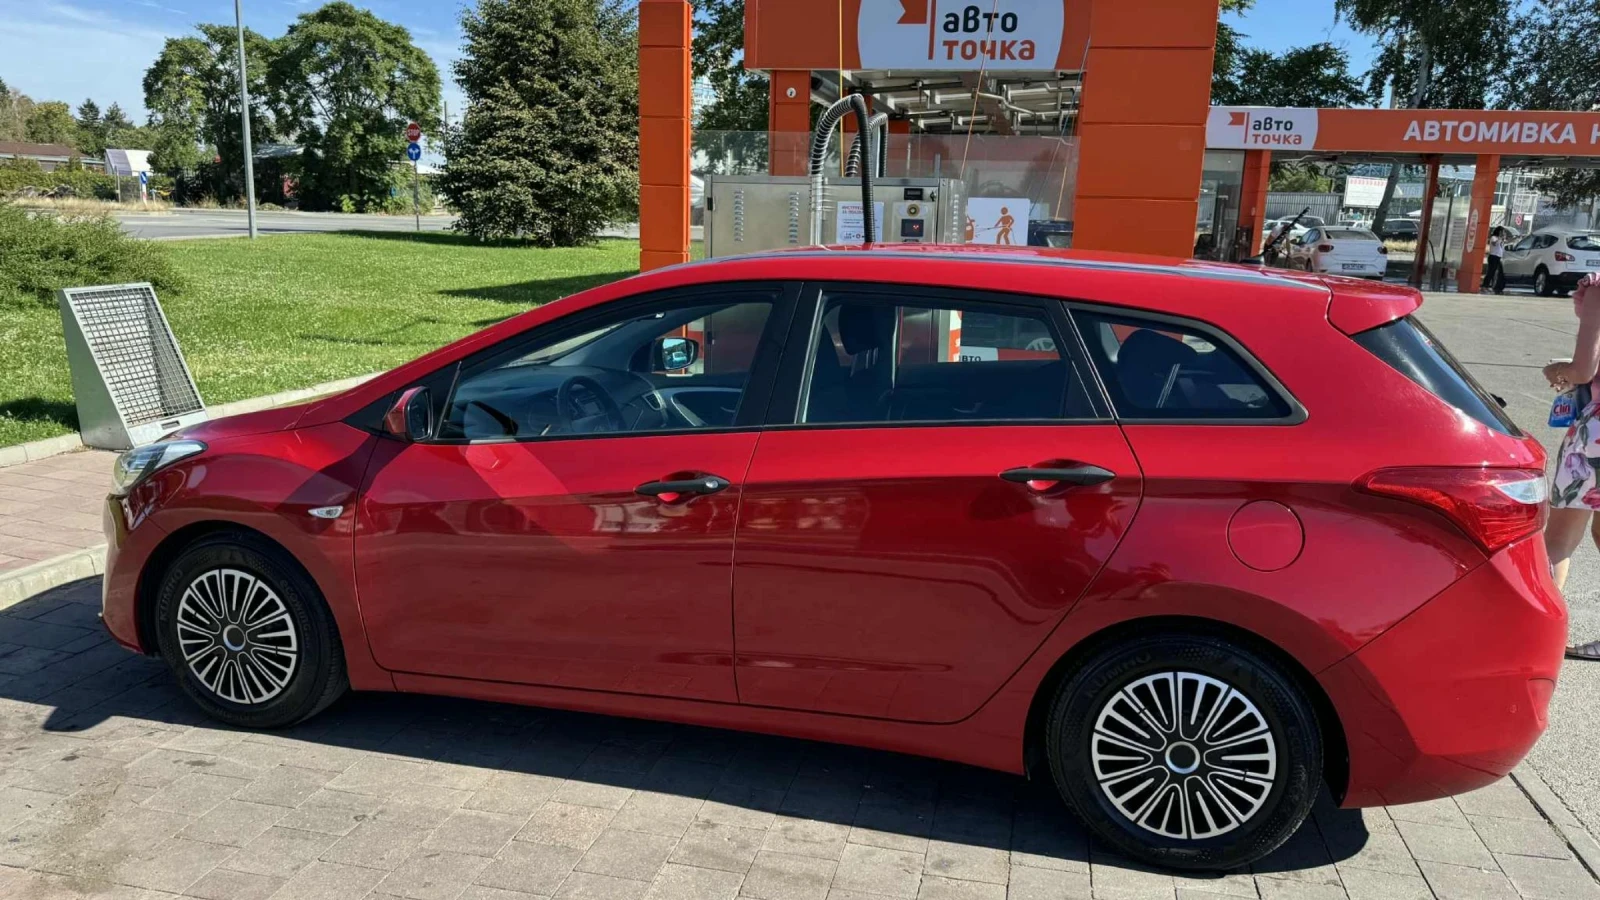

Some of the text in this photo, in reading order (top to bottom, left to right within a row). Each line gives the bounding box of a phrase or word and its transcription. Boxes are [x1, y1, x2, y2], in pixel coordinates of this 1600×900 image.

[943, 5, 1018, 32] авто
[942, 39, 1035, 60] точка
[1252, 116, 1294, 131] авто
[1403, 119, 1577, 144] АВТОМИВКА
[1252, 131, 1303, 145] точка
[1554, 403, 1571, 415] Clin
